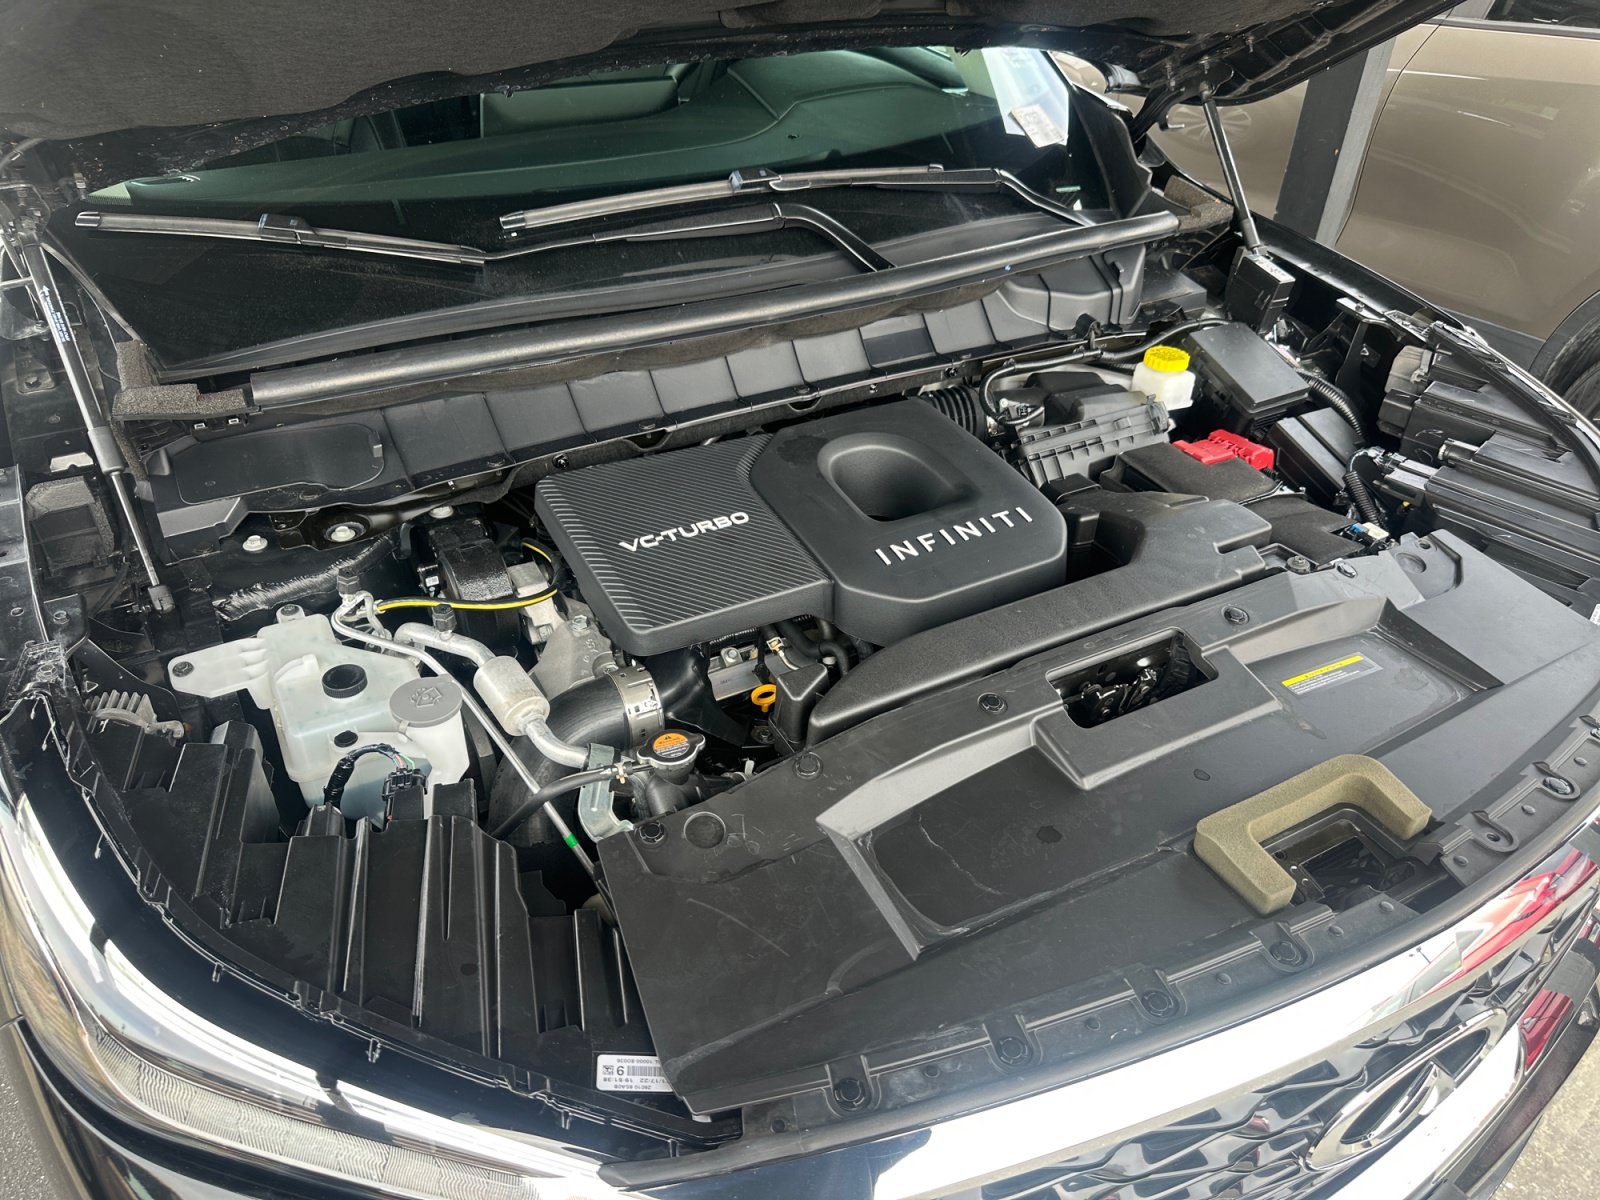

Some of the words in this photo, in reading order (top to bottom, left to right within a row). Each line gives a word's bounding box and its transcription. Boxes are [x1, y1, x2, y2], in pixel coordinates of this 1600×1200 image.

[618, 511, 750, 552] VC-TURBO
[874, 506, 1033, 566] INFINITI
[616, 1065, 625, 1076] 9
